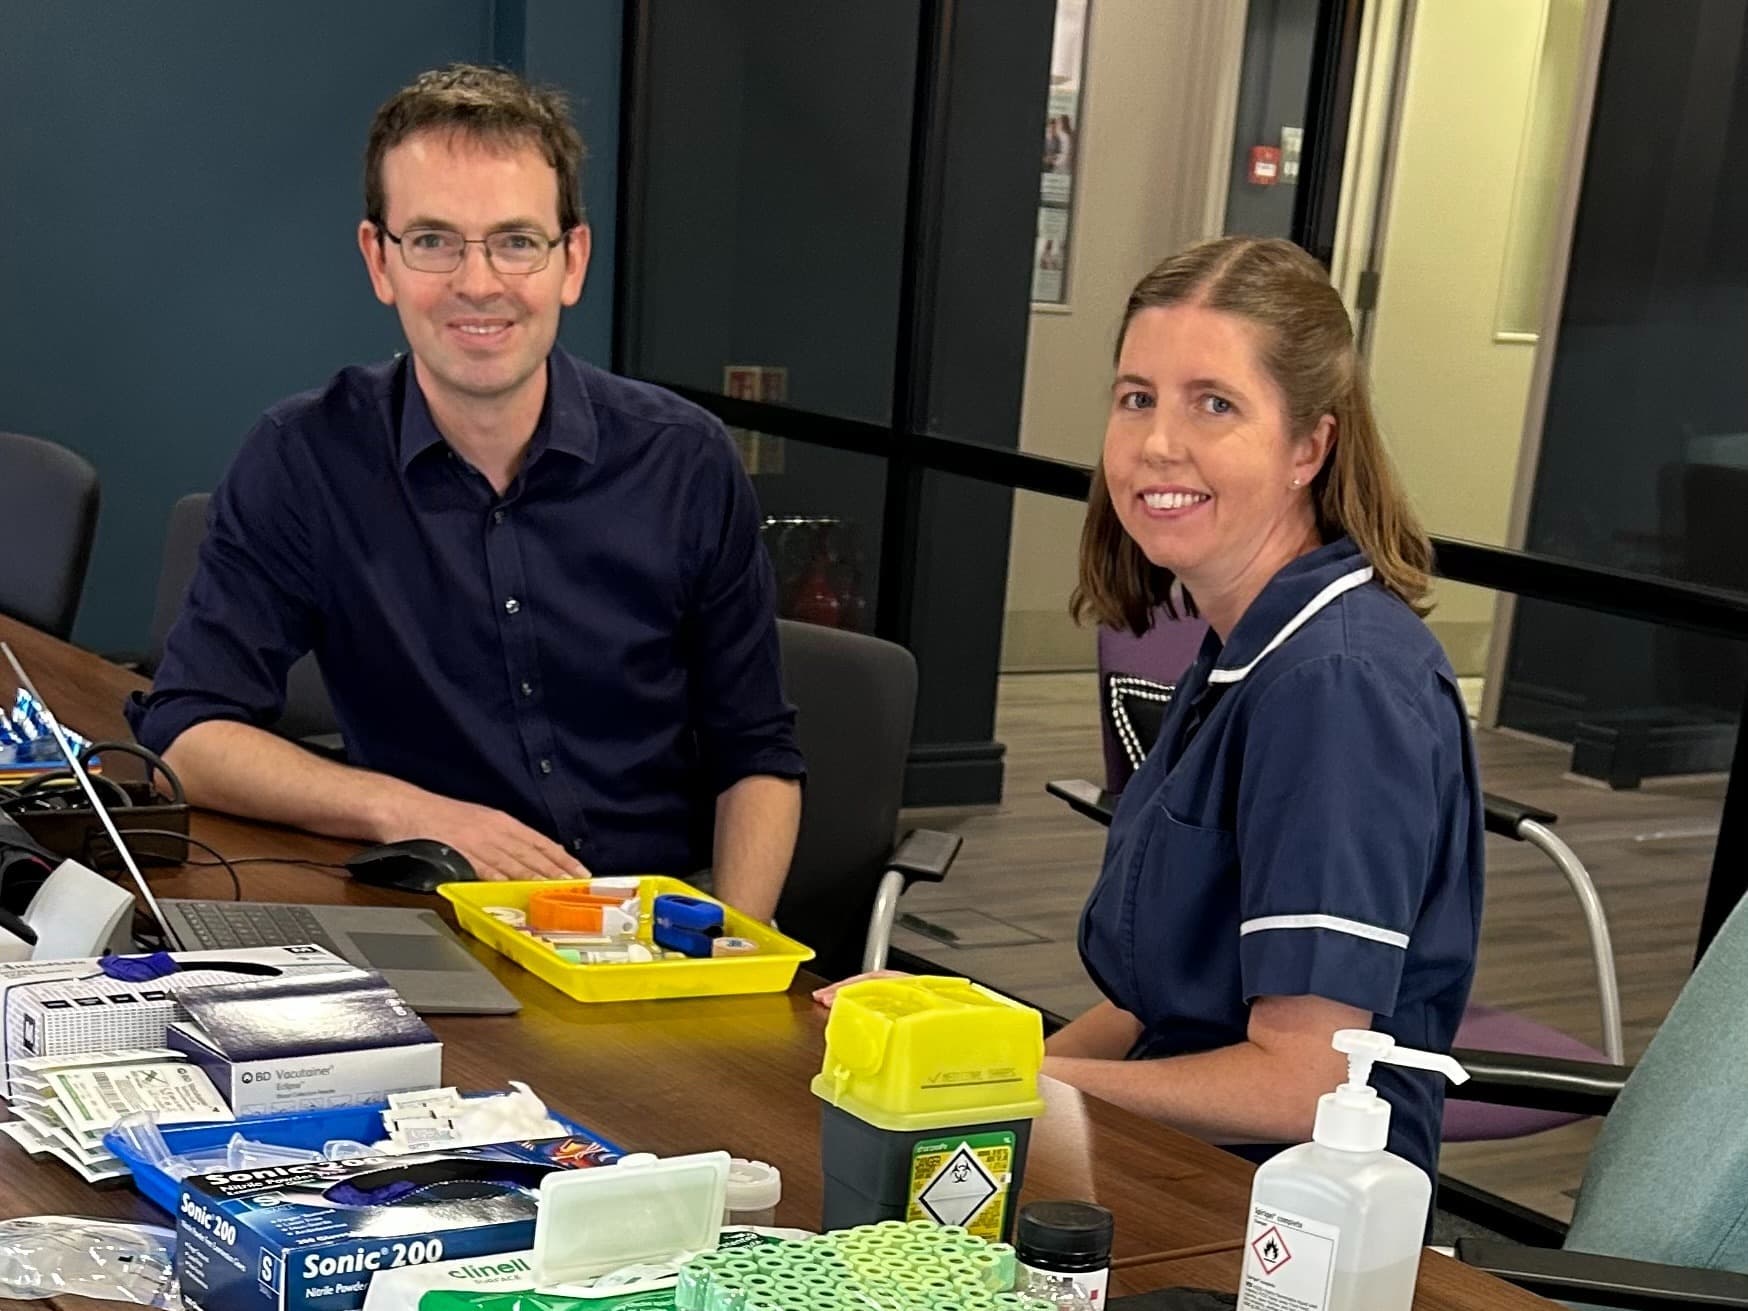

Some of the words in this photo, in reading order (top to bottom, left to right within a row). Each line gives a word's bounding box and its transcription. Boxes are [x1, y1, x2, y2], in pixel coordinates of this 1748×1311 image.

[205, 1164, 308, 1186] Sonic
[212, 1215, 237, 1246] 200
[390, 1238, 443, 1268] 200
[261, 1255, 273, 1282] S
[448, 1258, 532, 1279] clinell
